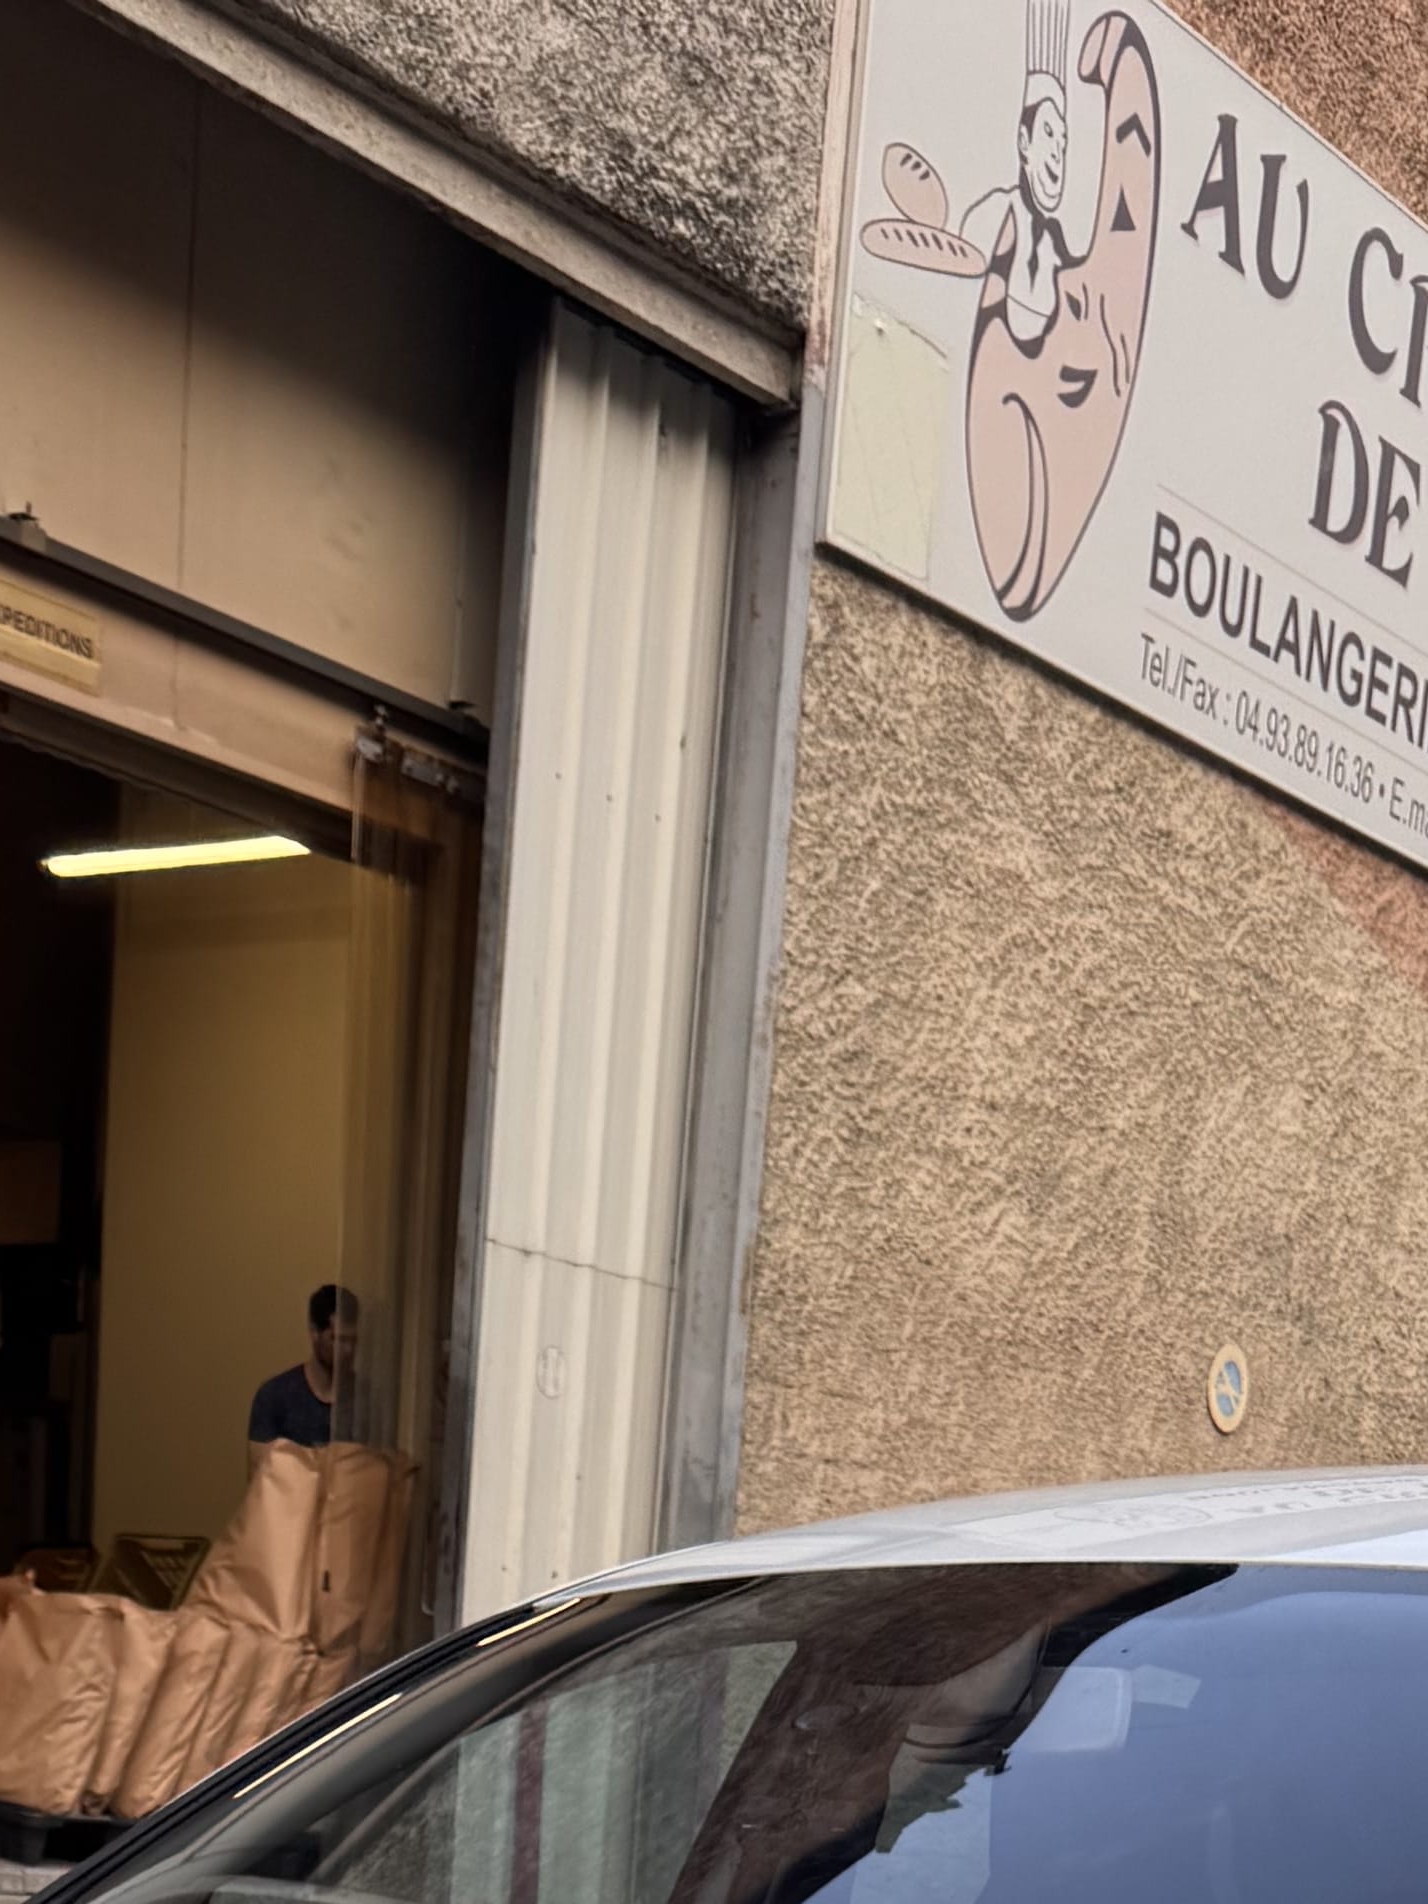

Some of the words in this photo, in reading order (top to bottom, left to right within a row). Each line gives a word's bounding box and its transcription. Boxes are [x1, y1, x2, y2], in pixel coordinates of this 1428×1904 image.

[1181, 113, 1309, 300] AU
[1308, 399, 1423, 589] DE
[1235, 690, 1376, 804] 04.93.89.16.36
